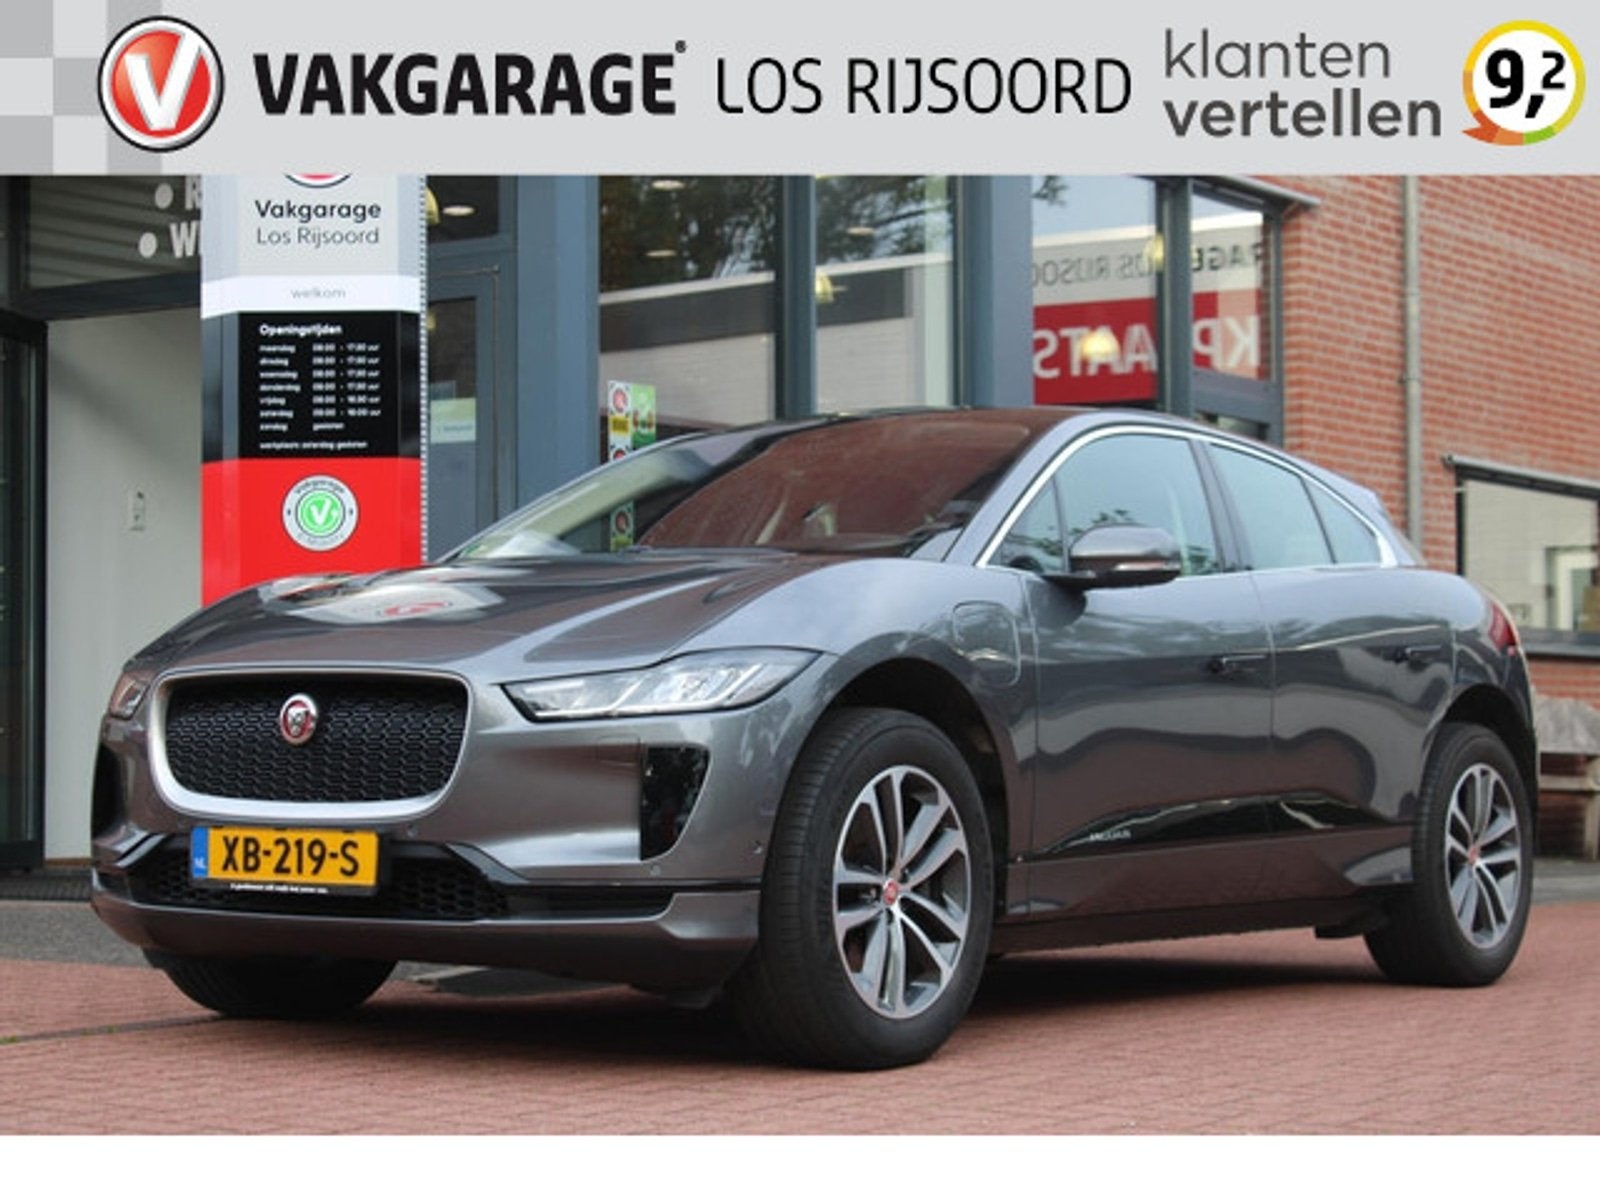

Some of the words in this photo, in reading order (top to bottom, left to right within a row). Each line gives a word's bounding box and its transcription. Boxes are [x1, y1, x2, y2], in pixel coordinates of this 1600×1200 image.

[254, 199, 382, 223] Vakgarage
[256, 227, 292, 246] Los
[298, 227, 380, 249] Rijsoord
[290, 286, 346, 300] welkom
[221, 835, 360, 878] XB-219-S
